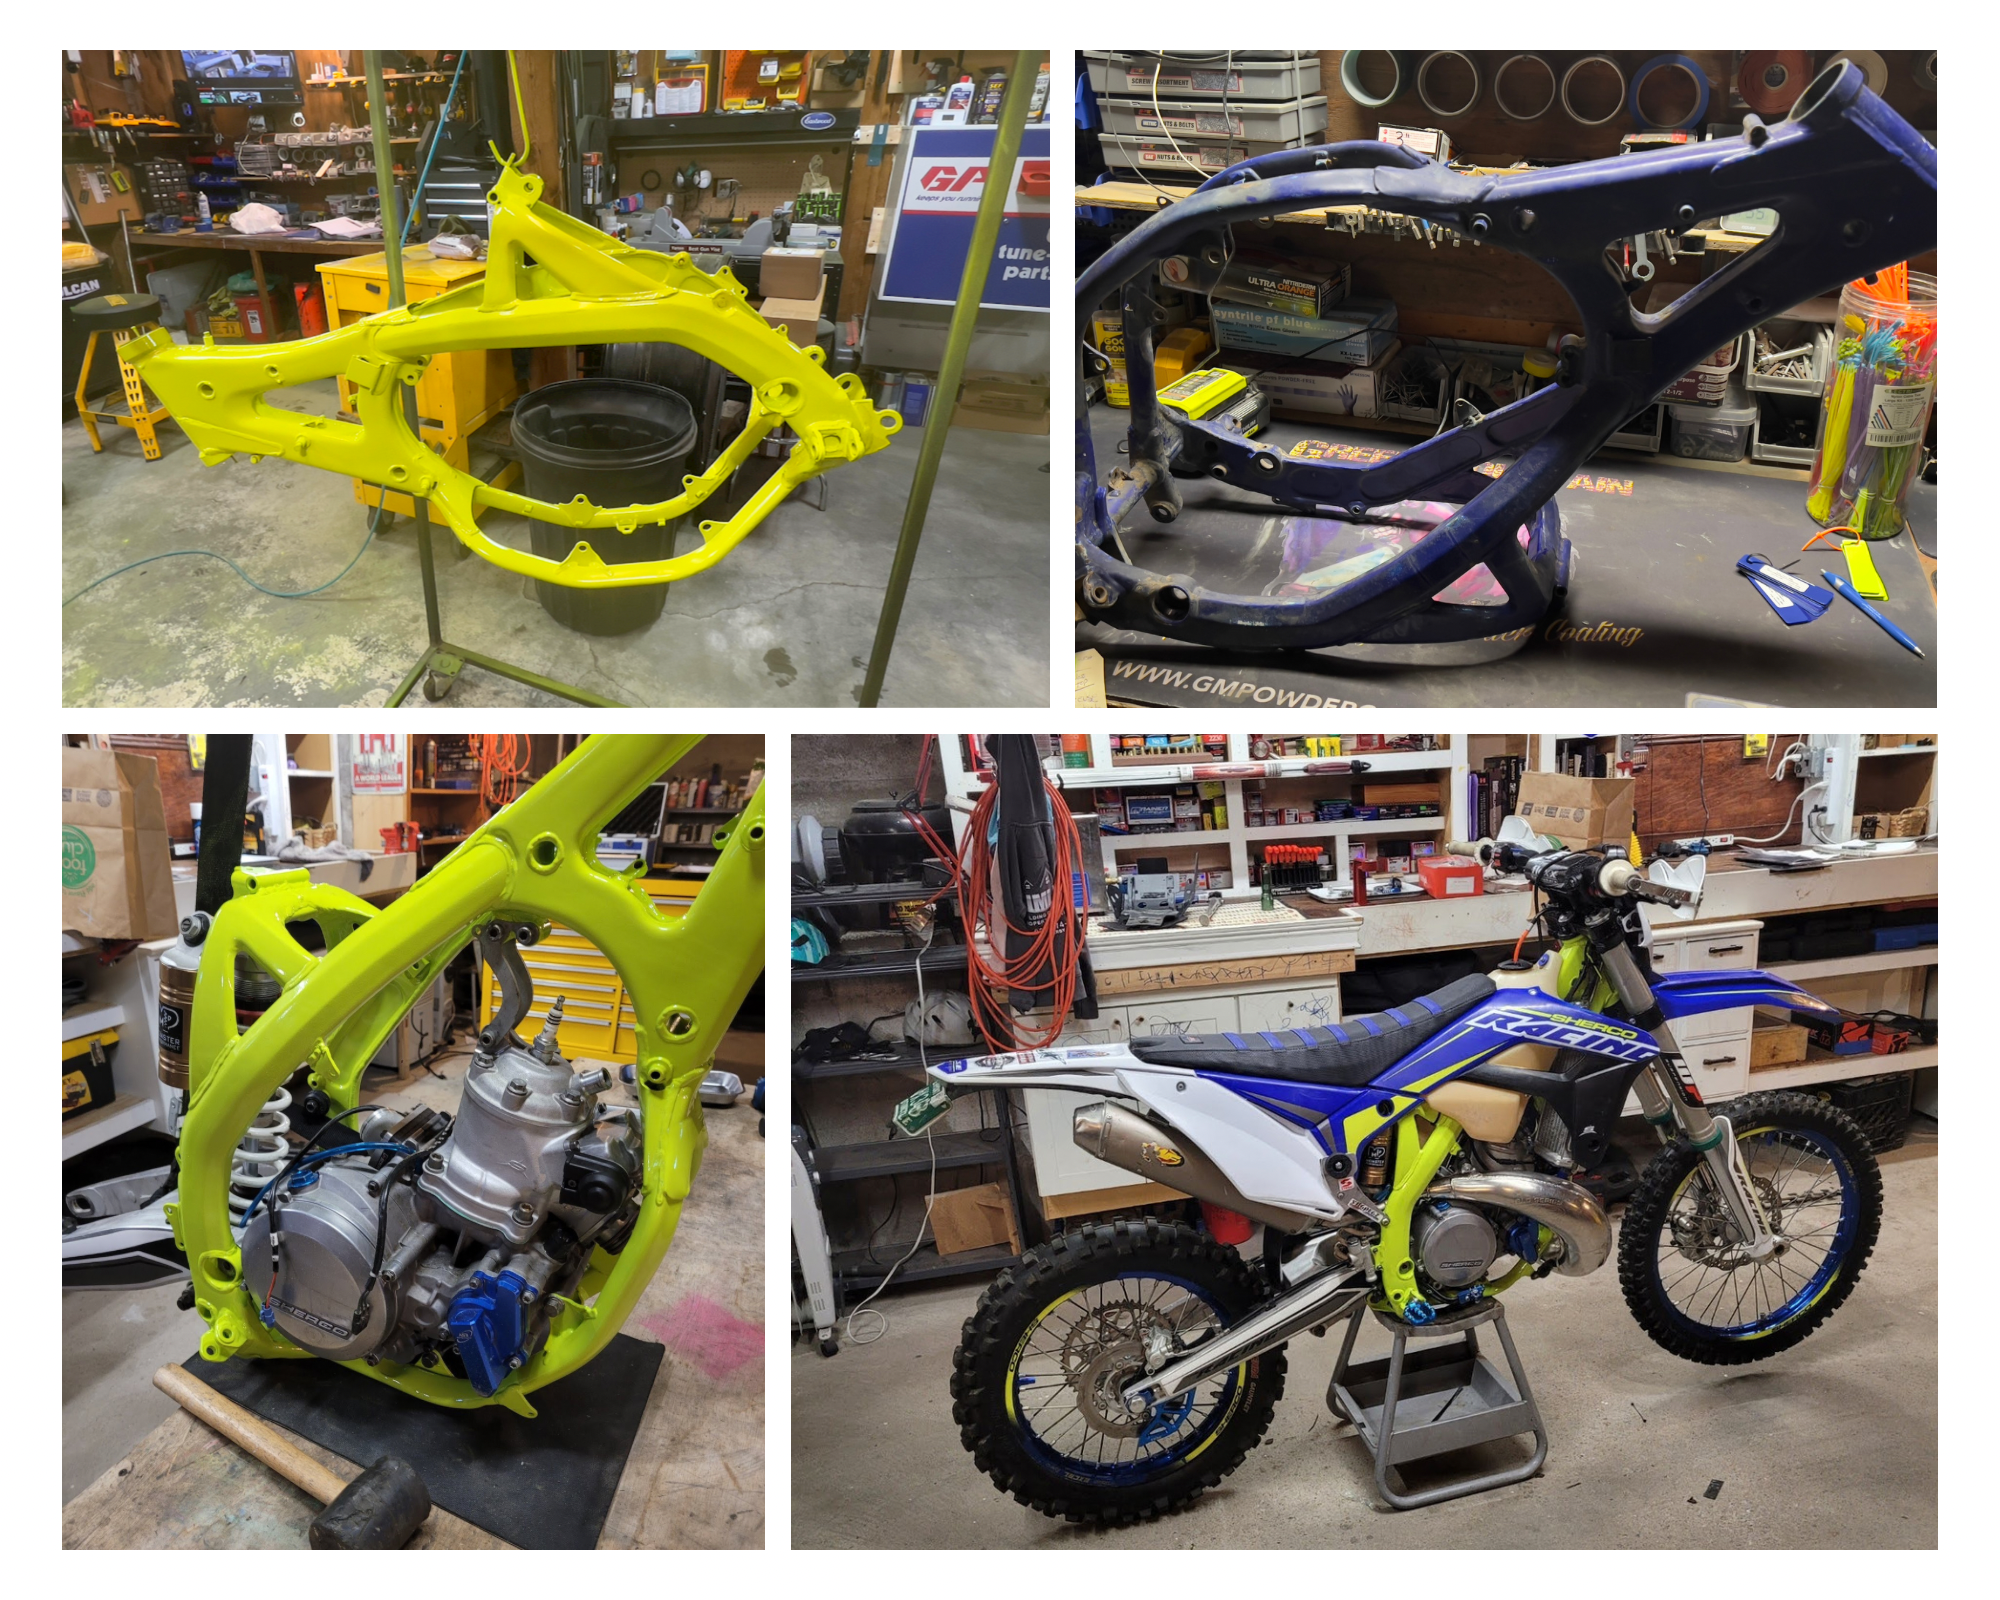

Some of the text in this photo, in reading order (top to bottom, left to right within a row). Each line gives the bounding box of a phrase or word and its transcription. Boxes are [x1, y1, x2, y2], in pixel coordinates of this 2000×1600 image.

[915, 194, 940, 203] keeps
[940, 195, 956, 203] you
[62, 279, 101, 298] LCAN
[1247, 276, 1315, 297] ULTRA ORANGE
[1282, 278, 1316, 291] NITRIDERM
[1213, 309, 1311, 329] syntrile pf blue
[1340, 350, 1365, 359] XX-Large
[1277, 375, 1316, 385] POWDER-FREE
[1544, 618, 1645, 648] Coating
[1208, 734, 1223, 742] 2230
[1550, 1013, 1638, 1040] SHERCO
[269, 1296, 348, 1337] SHERCO
